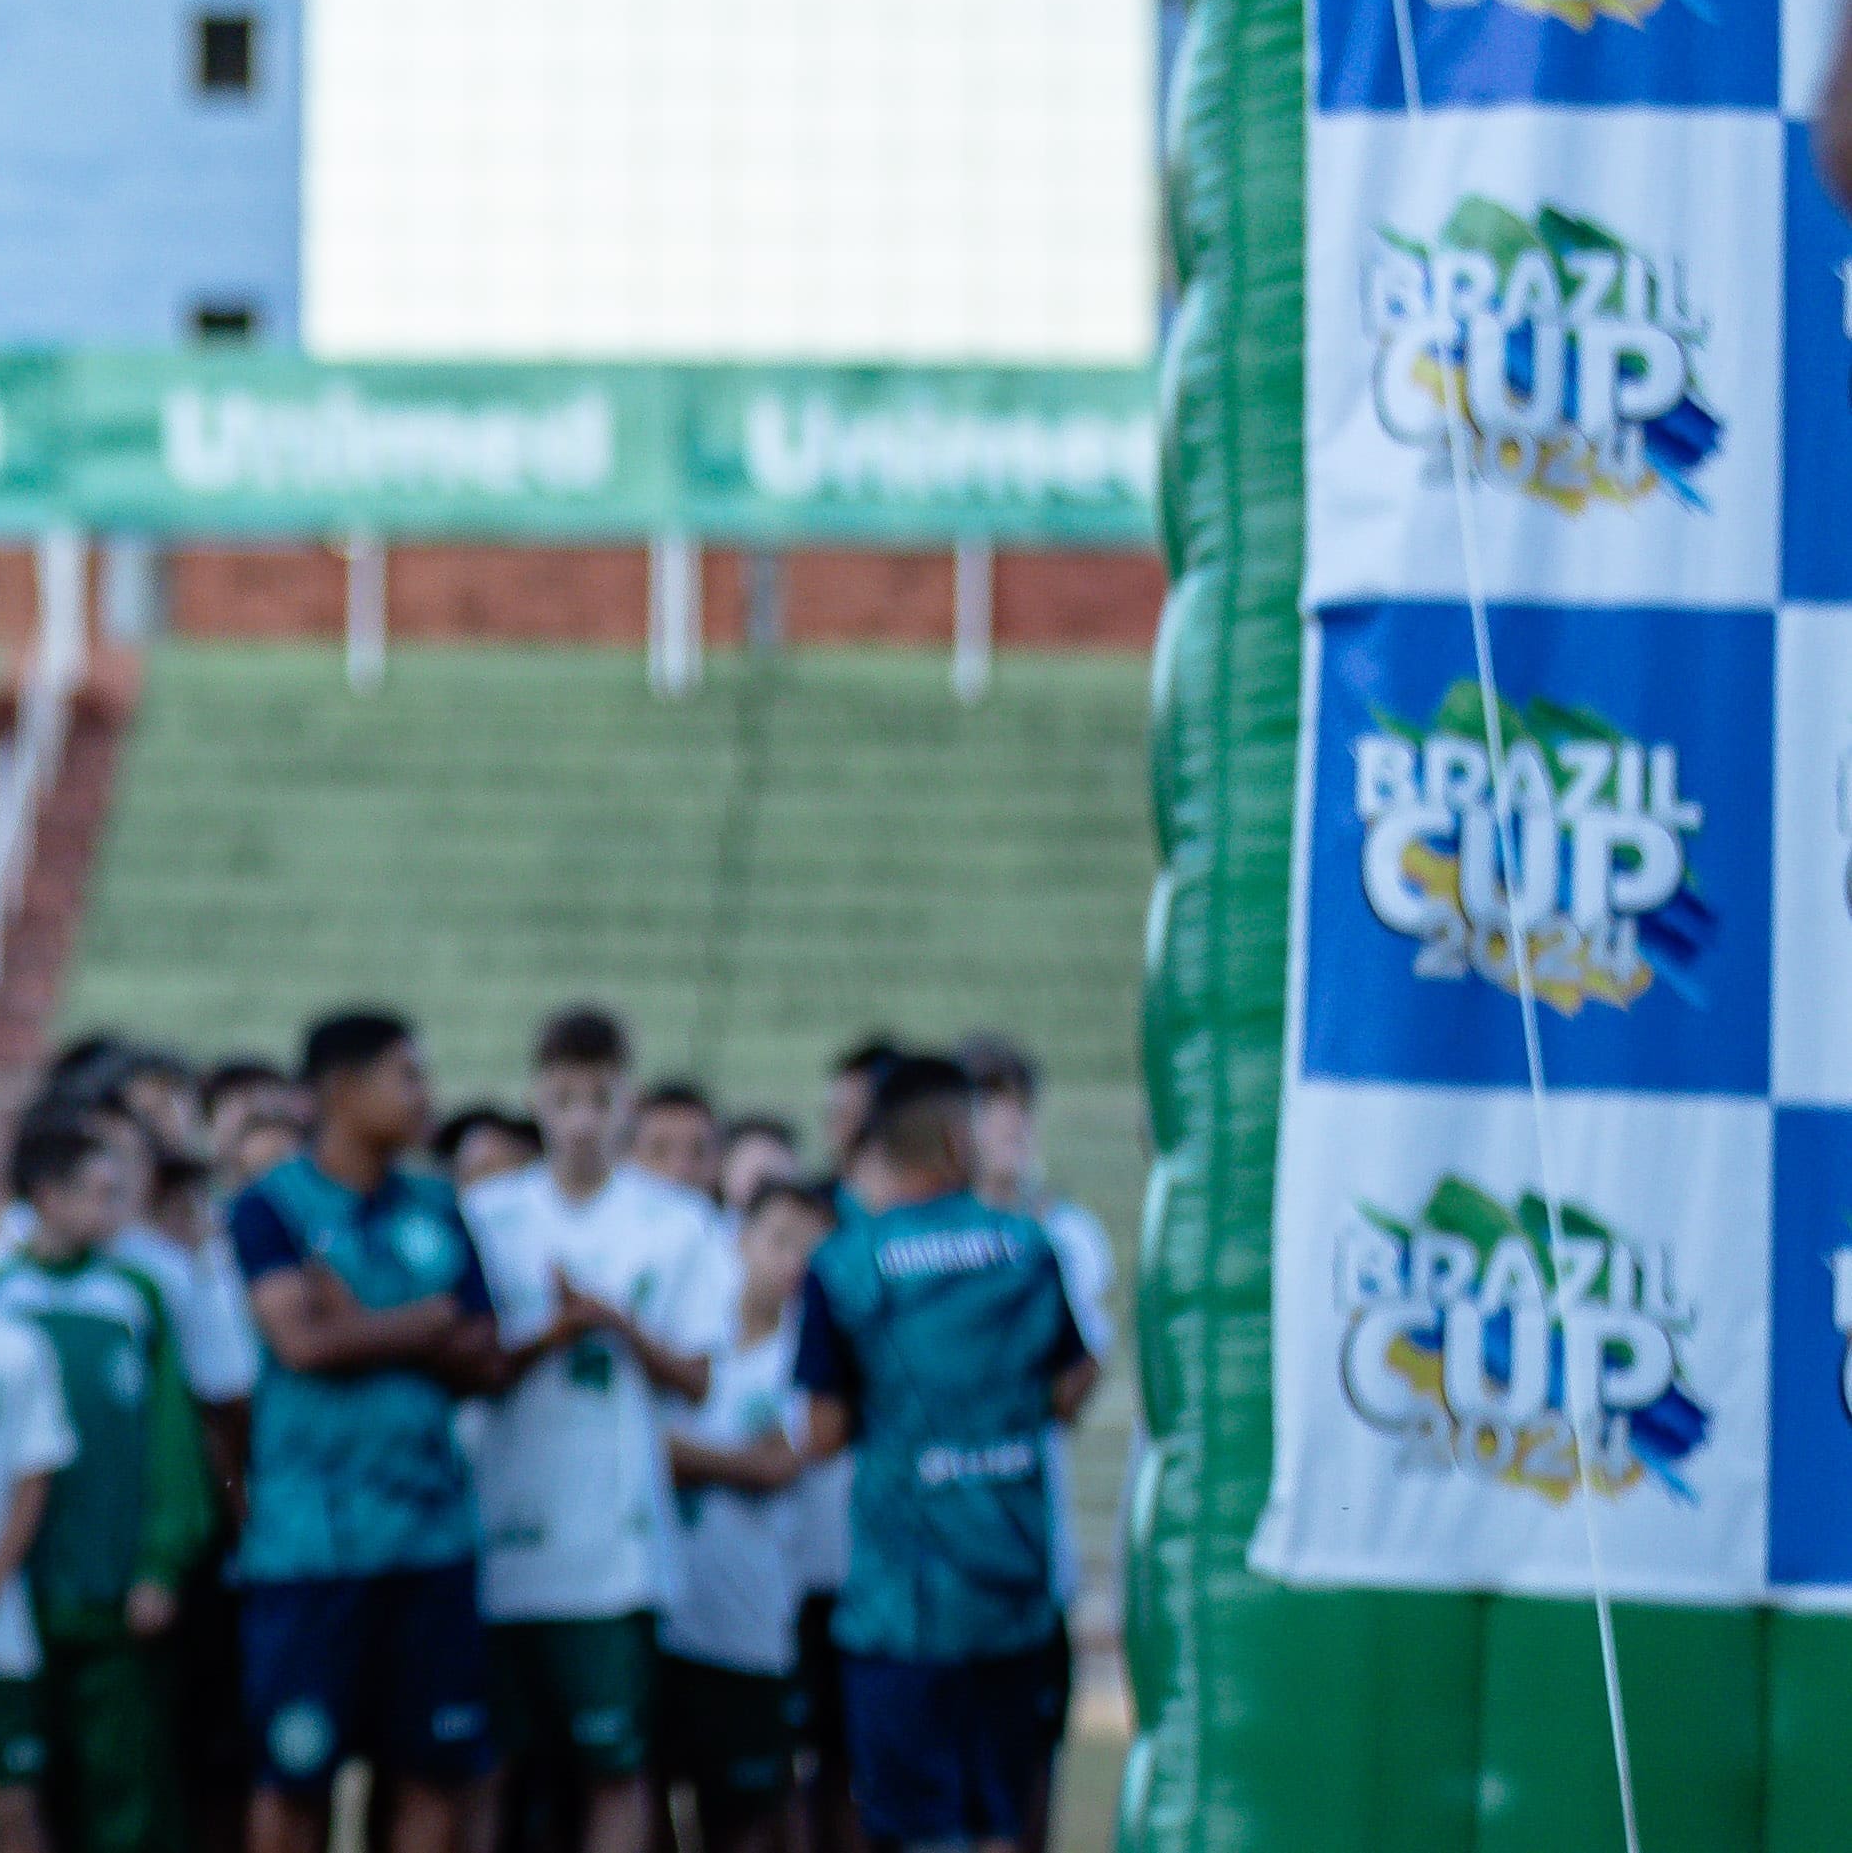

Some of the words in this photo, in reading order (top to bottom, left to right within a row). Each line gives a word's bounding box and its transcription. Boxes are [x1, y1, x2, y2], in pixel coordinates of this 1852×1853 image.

[1361, 248, 1708, 343] BRAZIL
[1373, 317, 1687, 444] CUP
[1354, 736, 1703, 830] BRAZIL
[1363, 809, 1683, 938] CUP
[1334, 1232, 1695, 1336] BRAZIL
[1342, 1297, 1673, 1434] CUP
